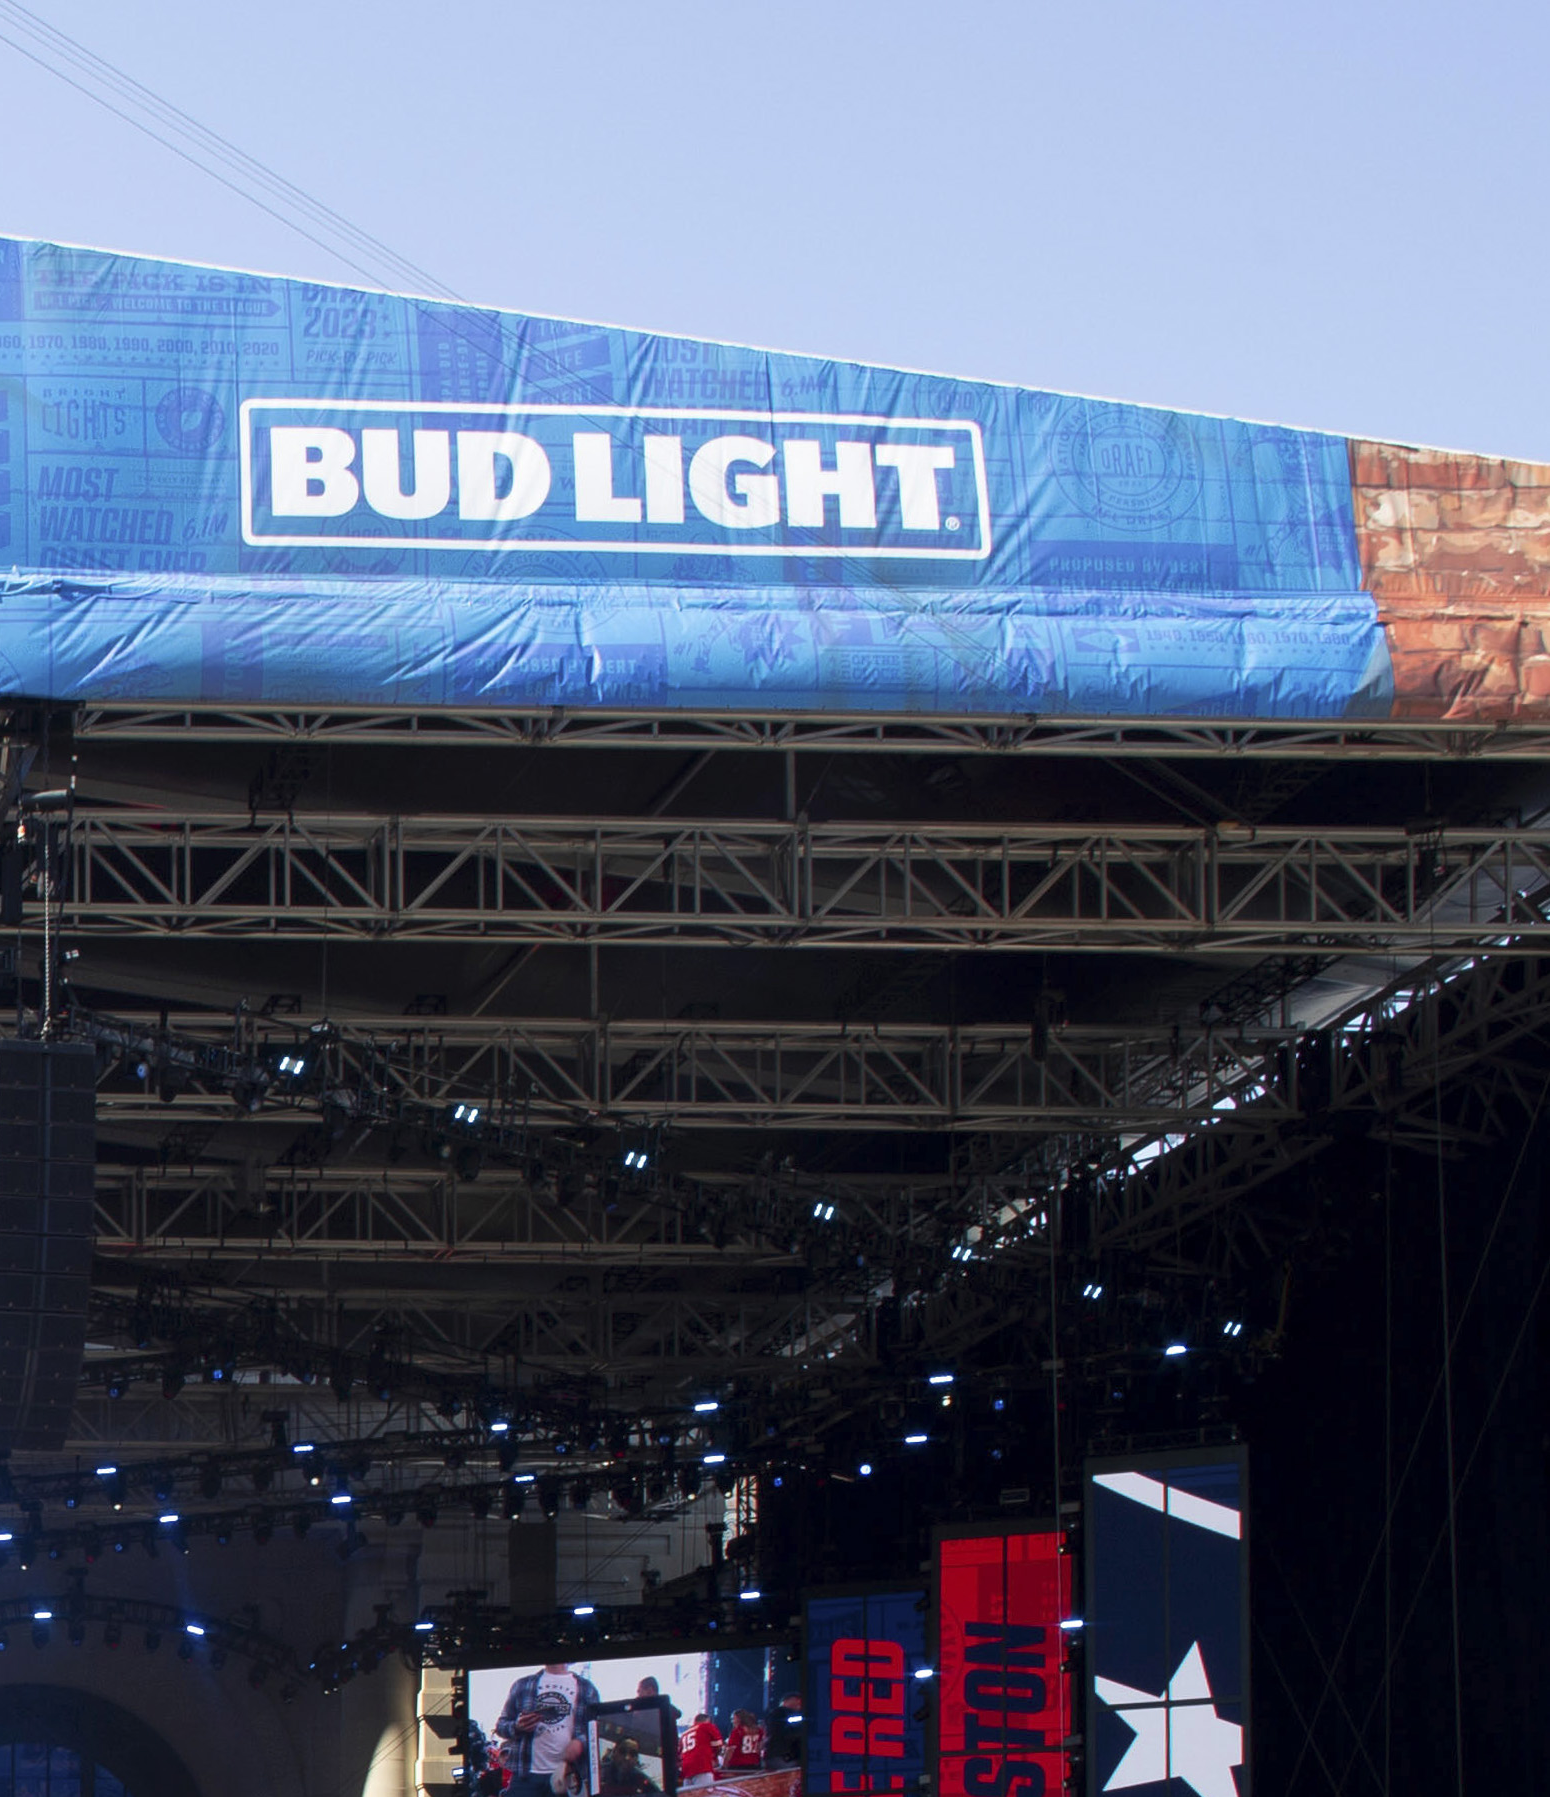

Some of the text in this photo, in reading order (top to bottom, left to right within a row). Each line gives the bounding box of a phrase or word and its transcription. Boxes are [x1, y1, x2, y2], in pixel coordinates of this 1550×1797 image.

[110, 272, 186, 291] PICK
[195, 275, 227, 292] IS
[235, 277, 272, 293] IN
[112, 298, 173, 311] WELCOME
[304, 307, 377, 339] 2023
[243, 341, 279, 356] 2020
[38, 466, 119, 502] MOST
[270, 427, 955, 531] BUD LIGHT
[39, 506, 174, 545] WATCHED
[181, 512, 229, 541] 6.1M
[830, 1638, 905, 1756] RED
[682, 1731, 696, 1753] 15
